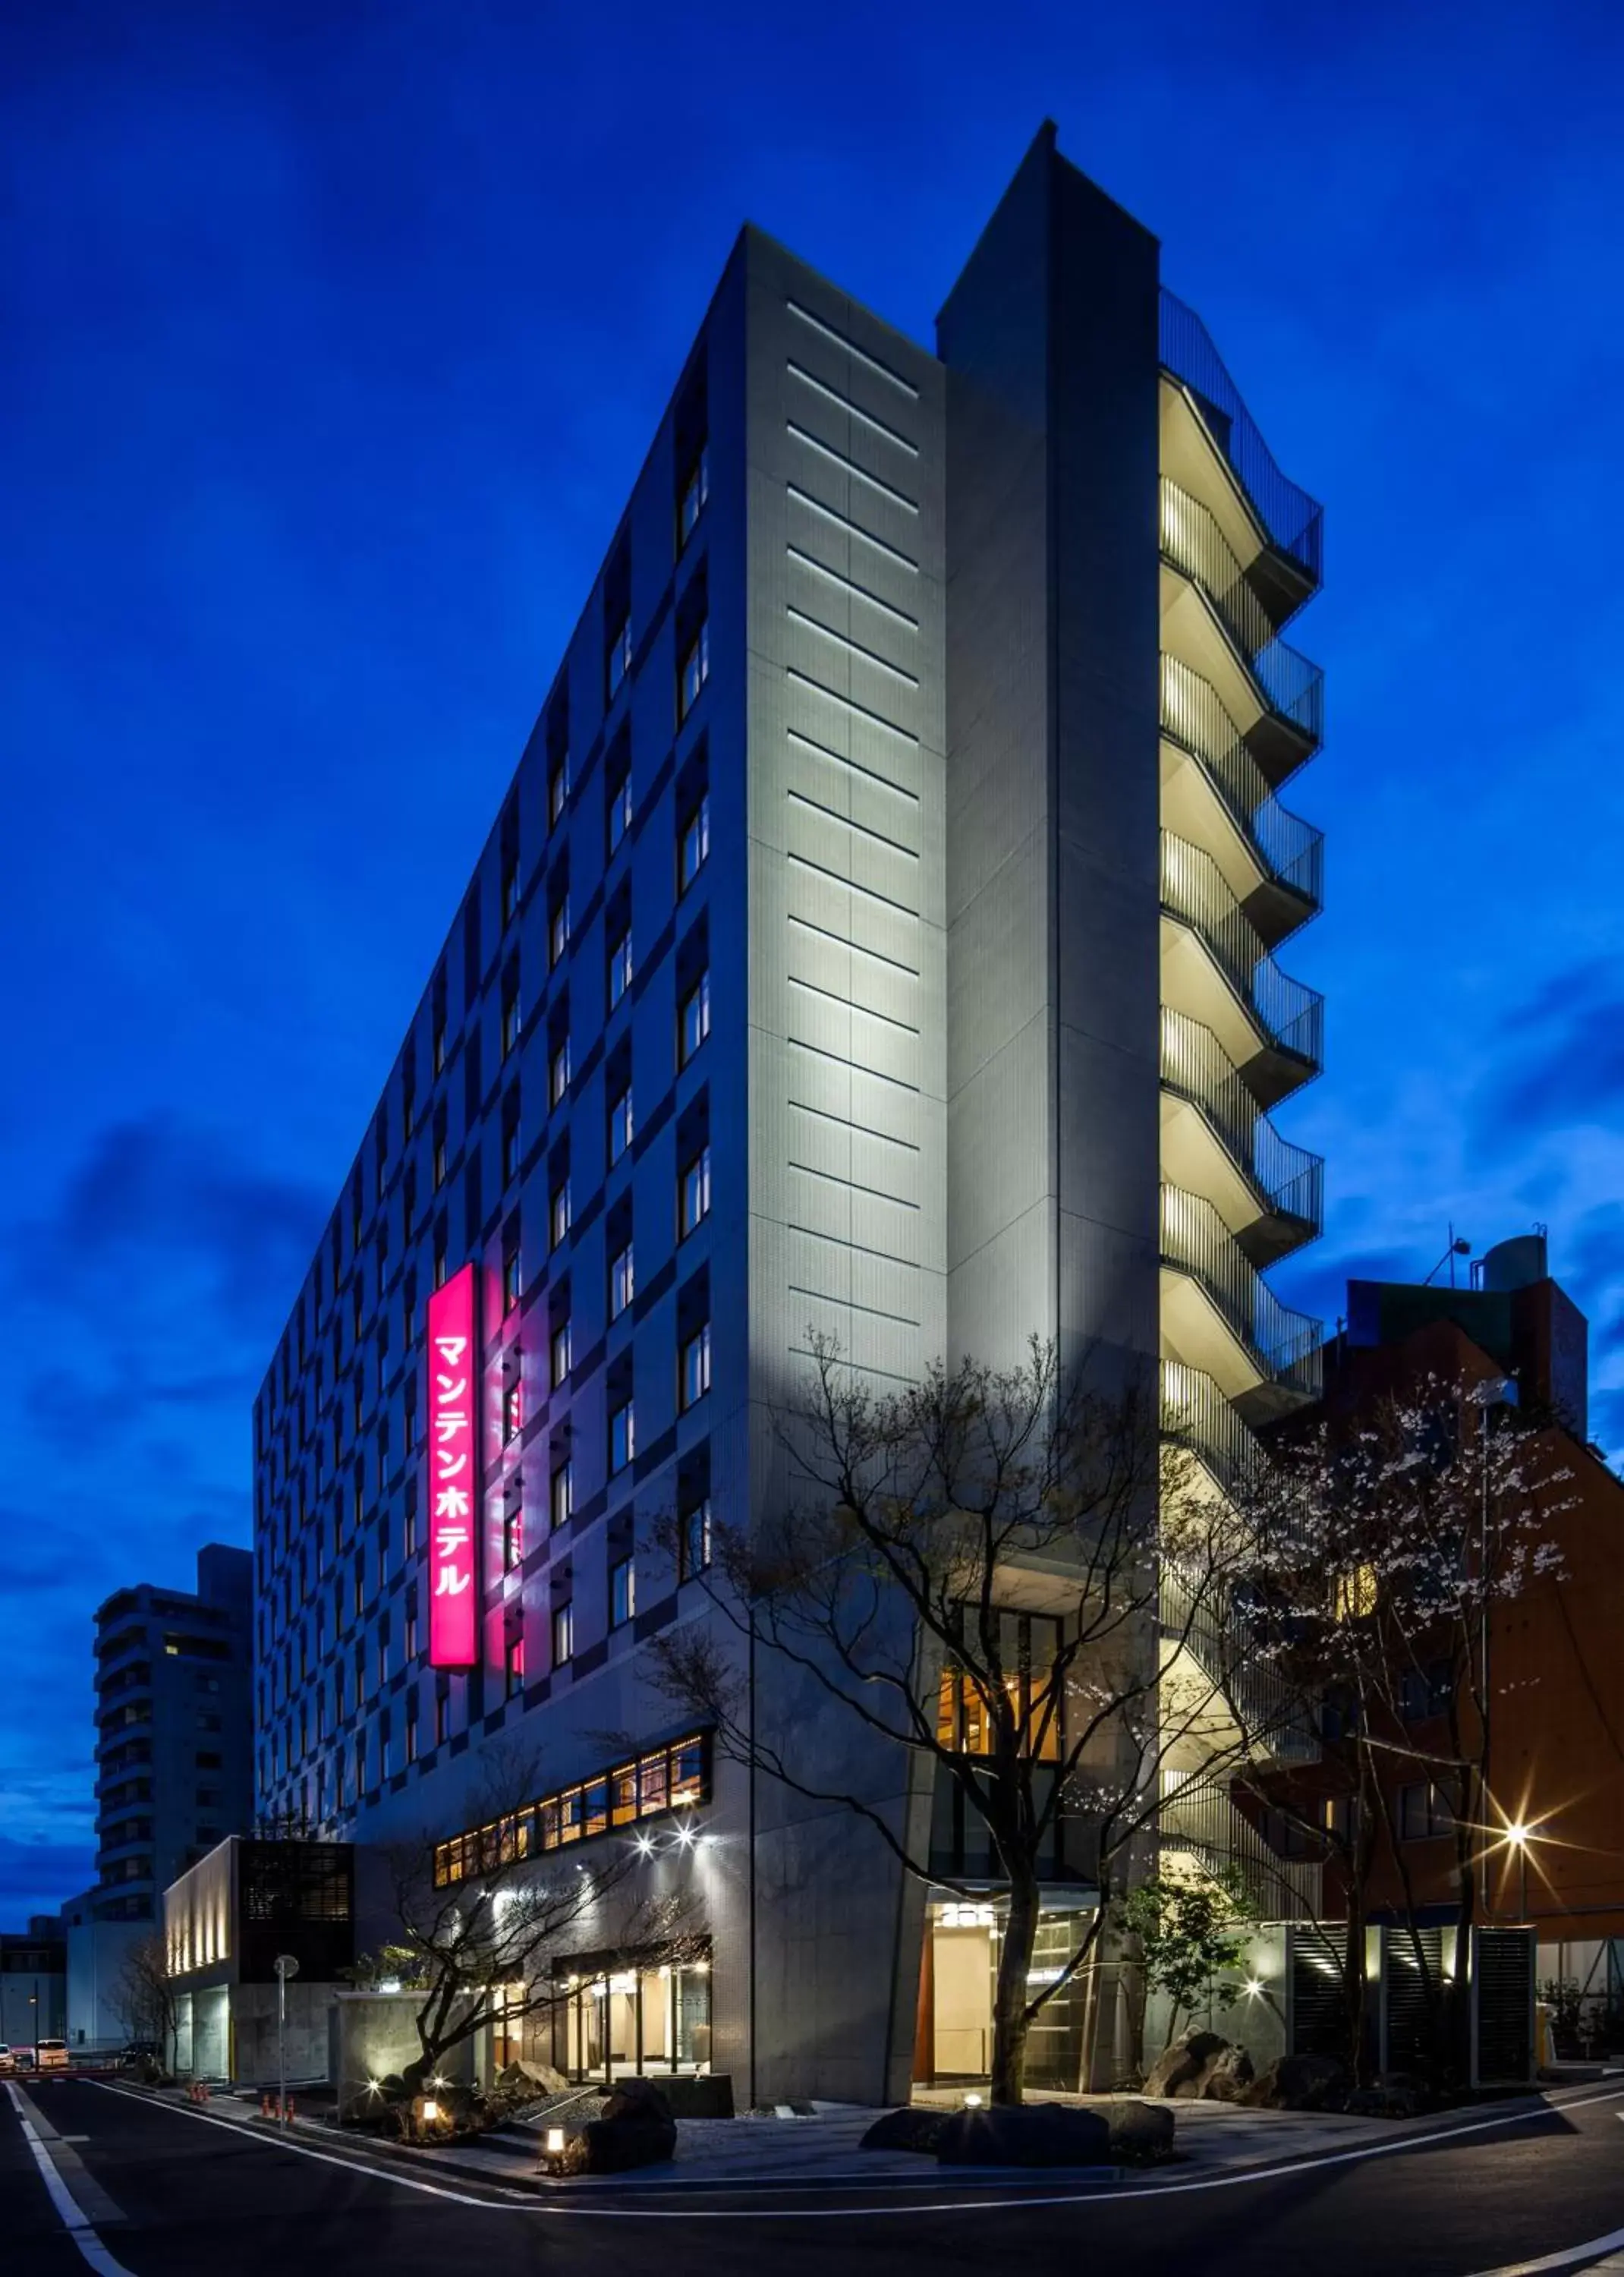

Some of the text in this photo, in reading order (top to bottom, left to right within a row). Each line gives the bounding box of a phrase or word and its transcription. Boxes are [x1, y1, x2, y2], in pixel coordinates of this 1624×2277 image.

[435, 1337, 471, 1596] マンテンホテル
